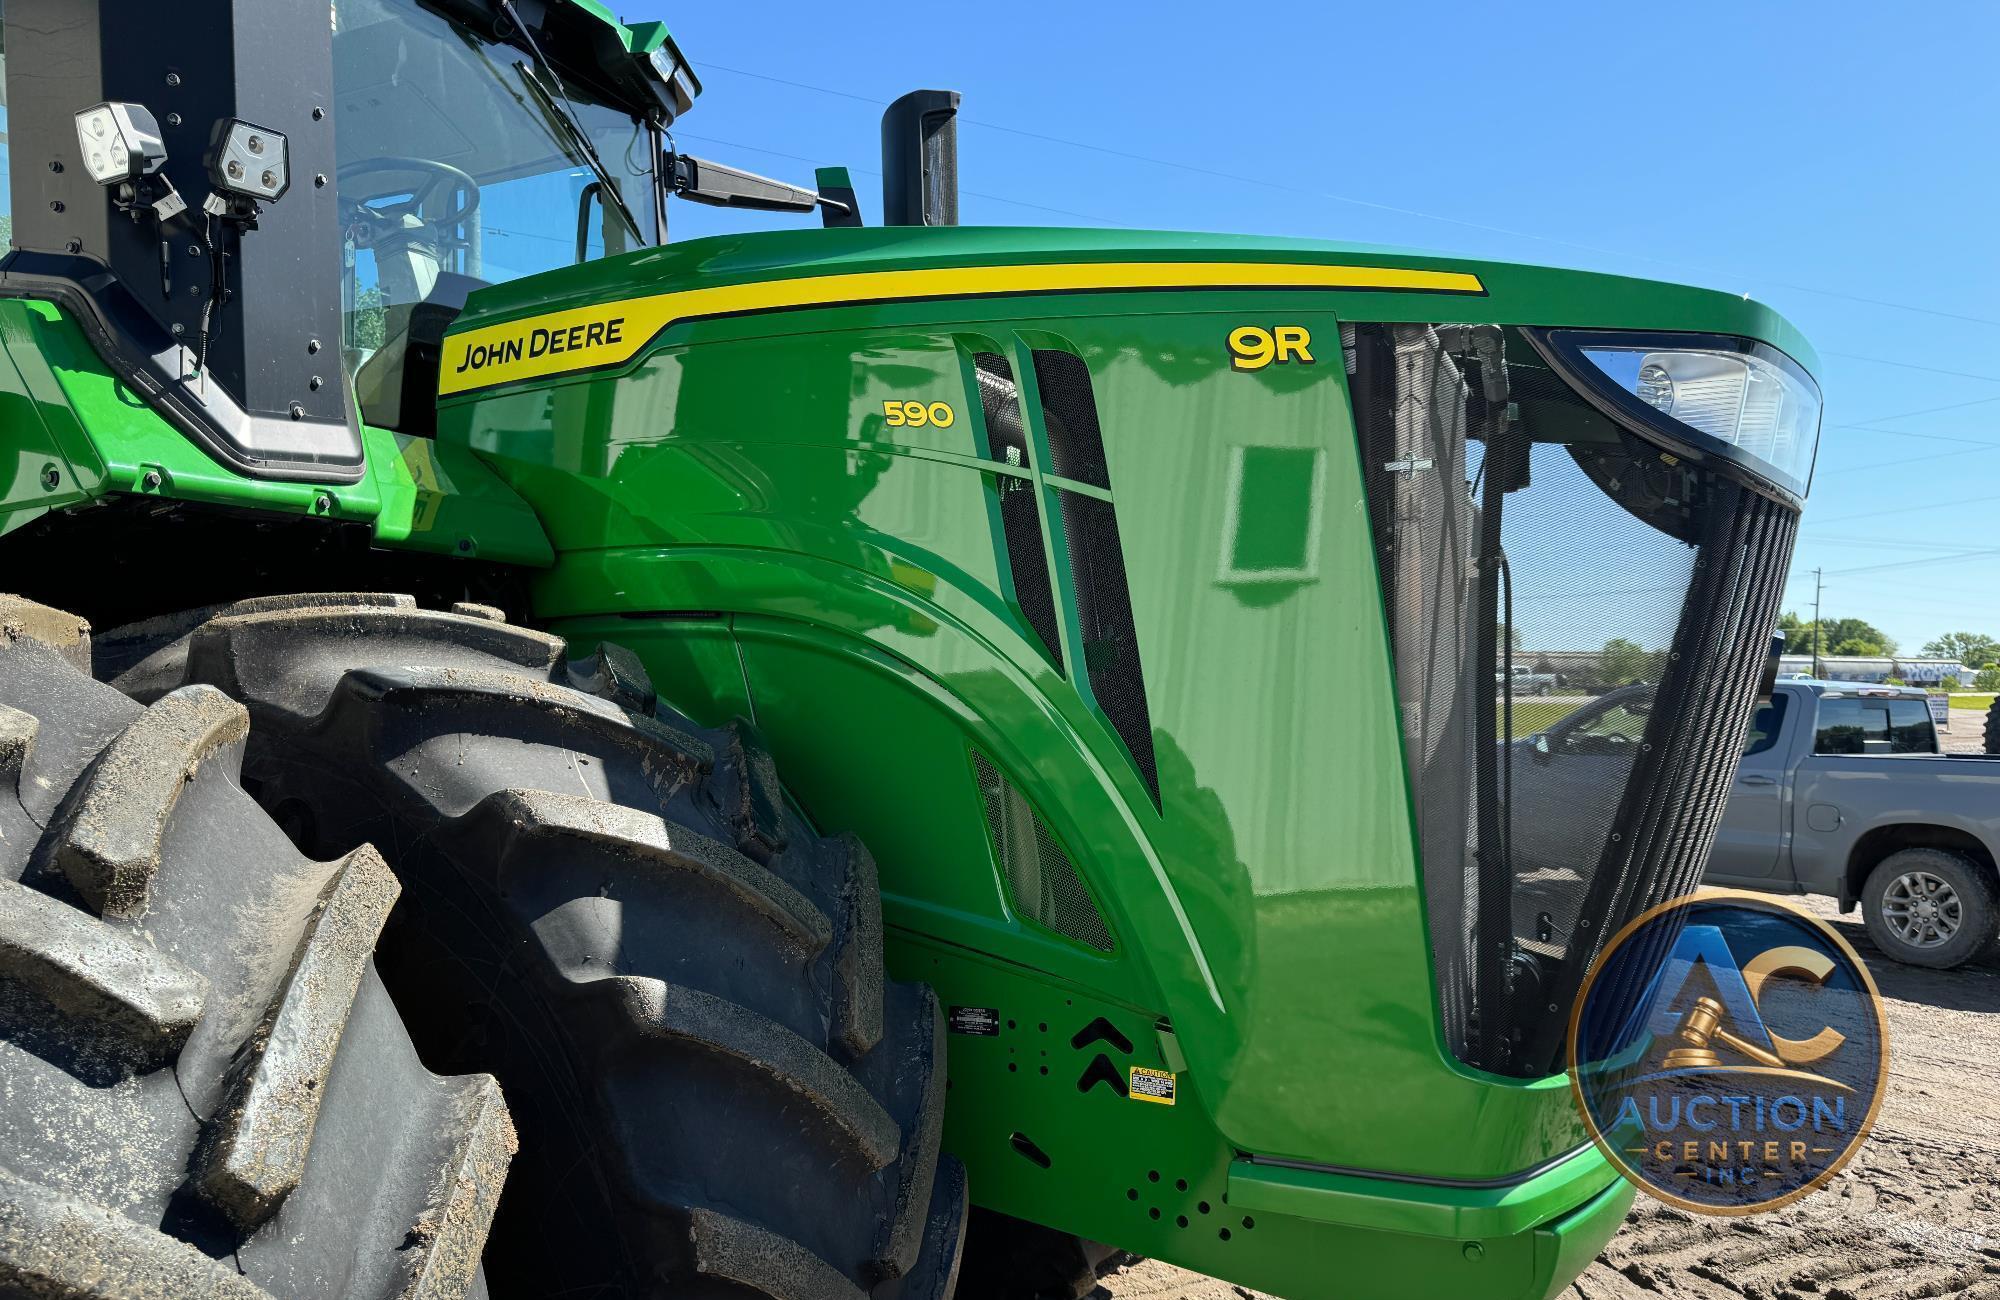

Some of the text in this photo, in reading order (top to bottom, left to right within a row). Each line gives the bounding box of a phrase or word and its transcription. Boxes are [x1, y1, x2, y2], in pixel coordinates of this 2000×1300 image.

[457, 318, 625, 373] JOHN DEERE
[1225, 326, 1316, 373] 9R
[883, 400, 955, 429] 590
